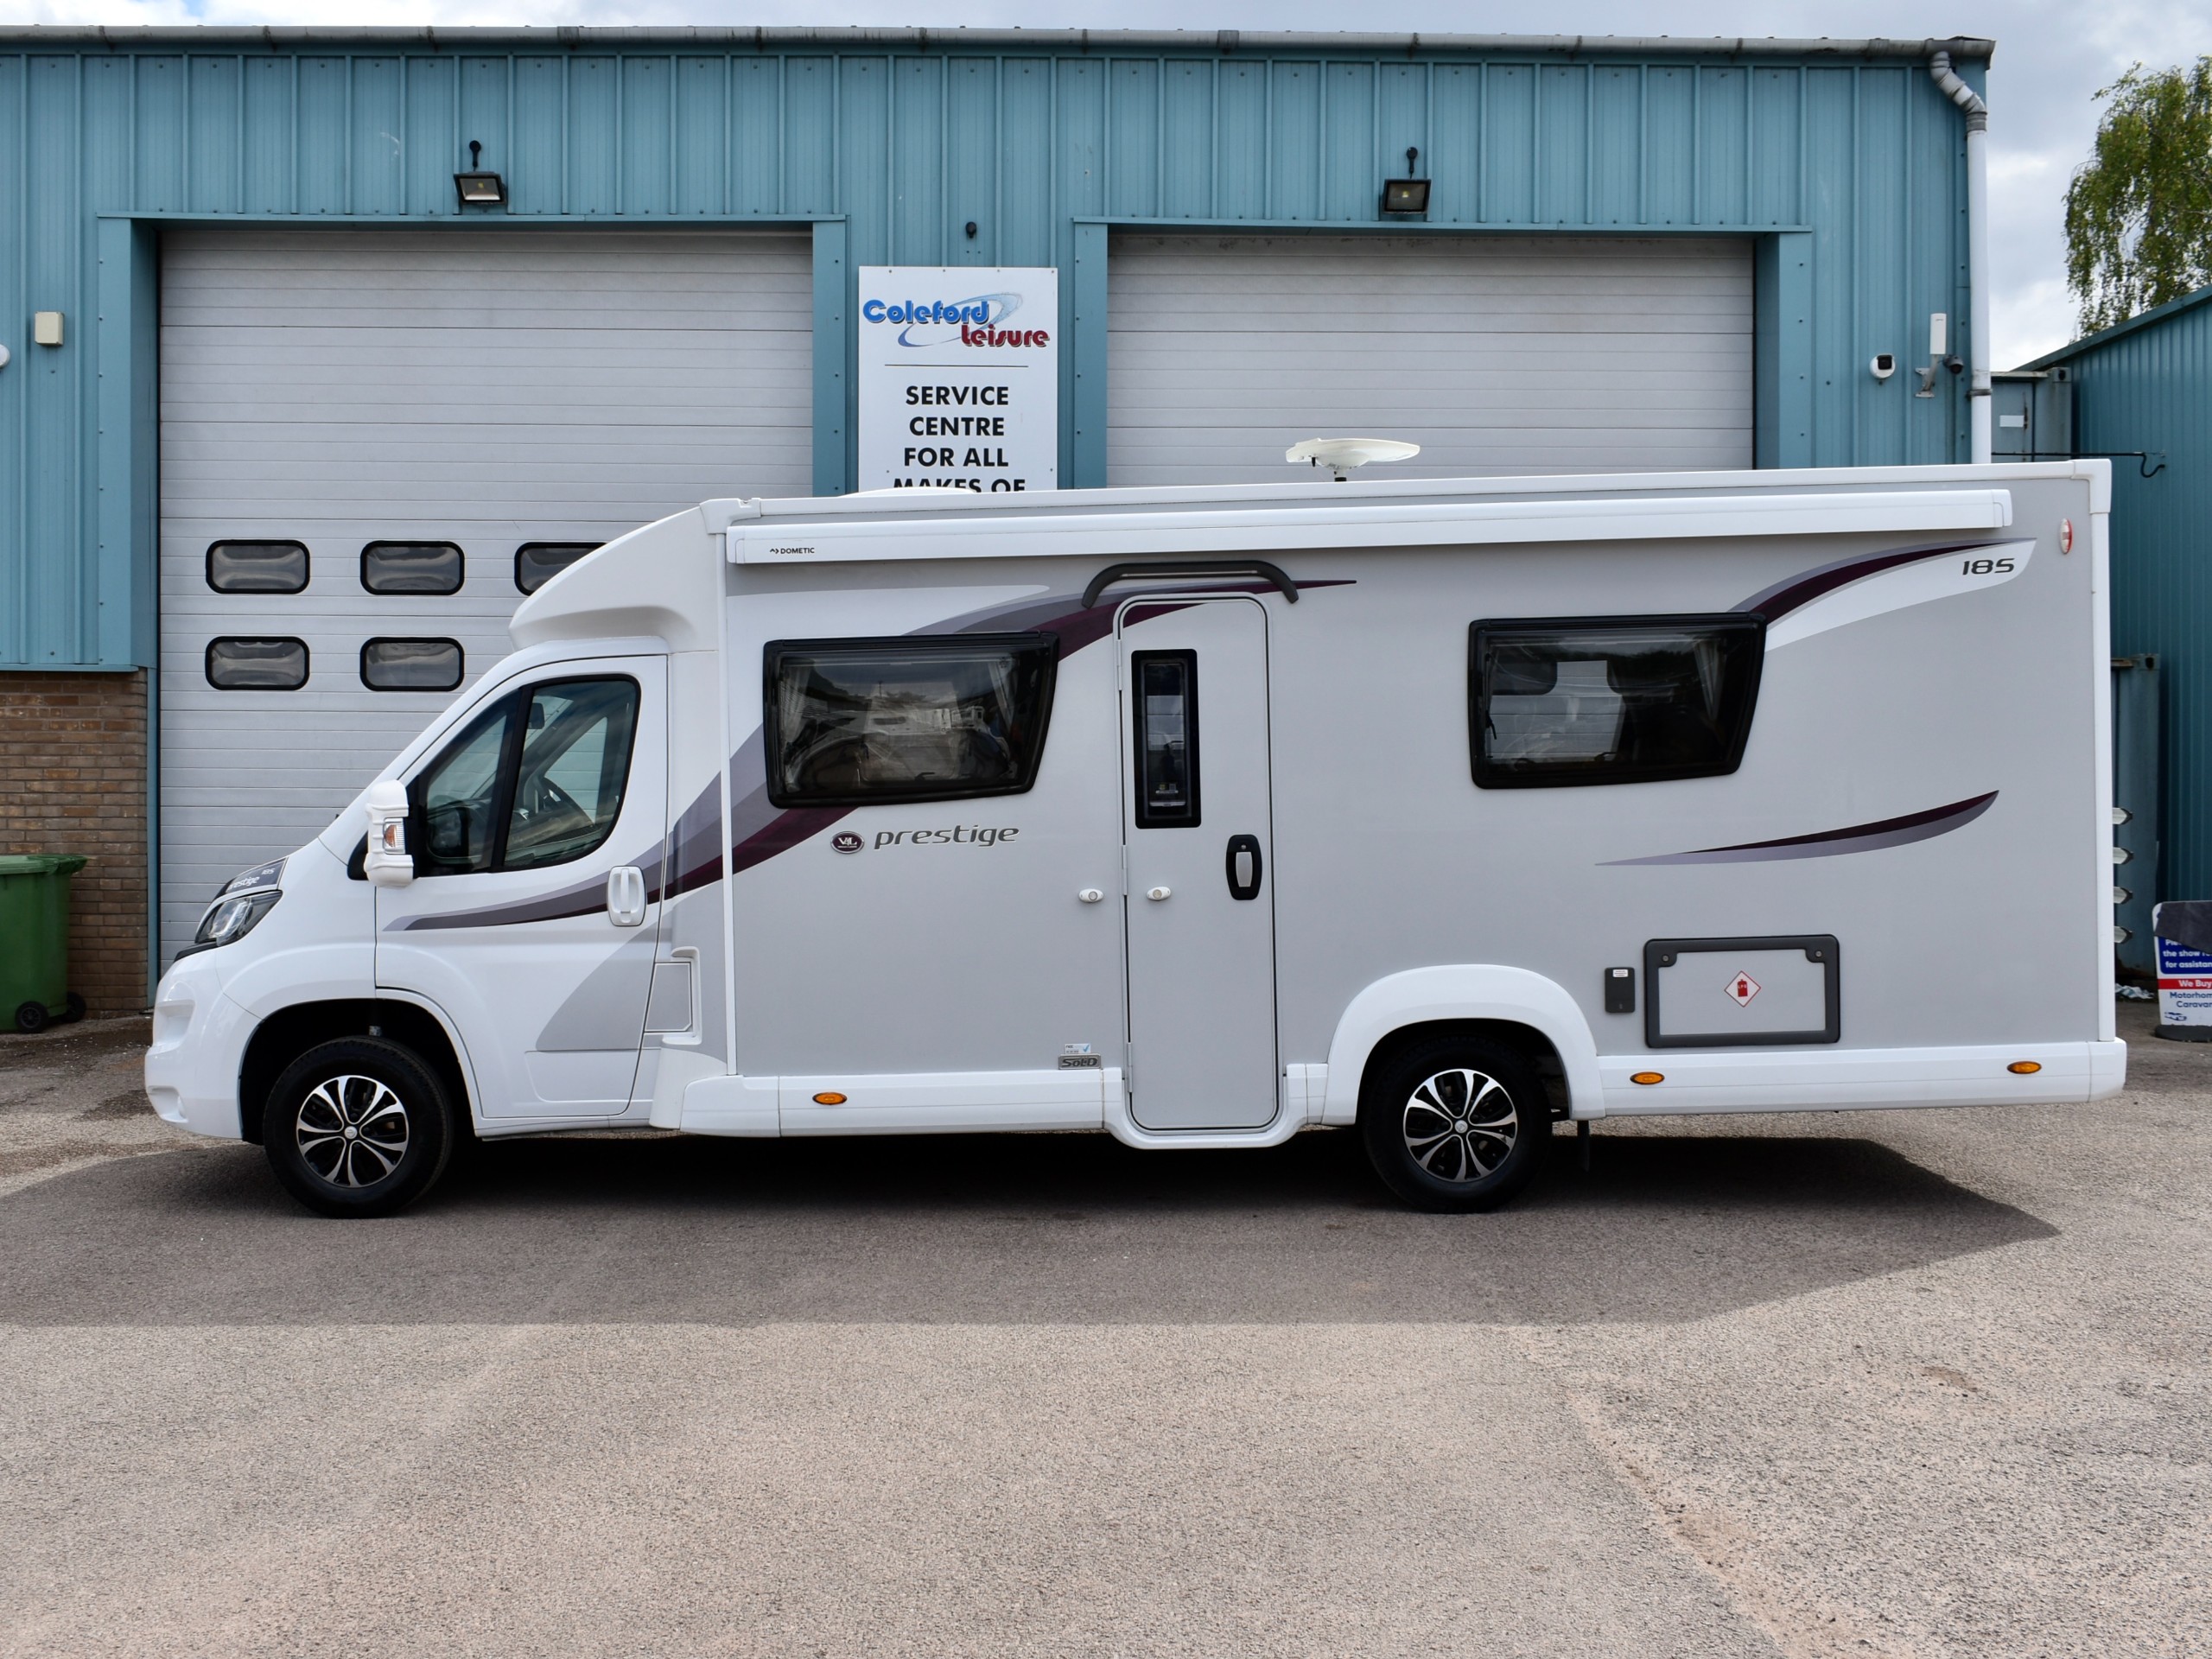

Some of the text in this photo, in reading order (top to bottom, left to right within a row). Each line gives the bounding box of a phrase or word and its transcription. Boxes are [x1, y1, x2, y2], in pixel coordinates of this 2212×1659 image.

[862, 299, 989, 325] Coleford
[961, 324, 1050, 347] Leisure
[906, 385, 1009, 405] SERVICE
[909, 416, 1004, 436] CENTRE
[904, 447, 1009, 467] FOR ALL
[874, 824, 1020, 850] prestige
[2195, 979, 2212, 988] Buy
